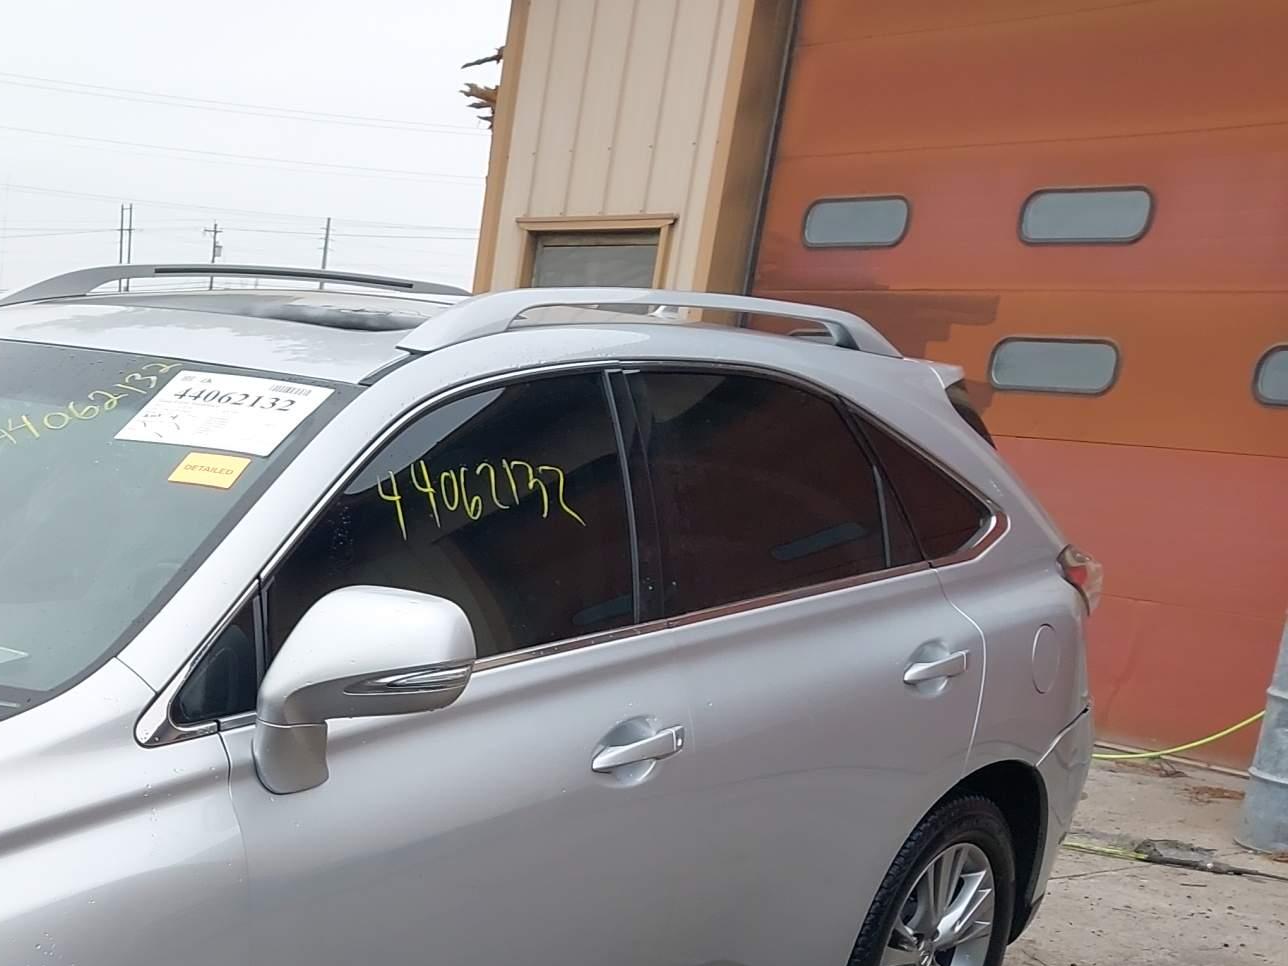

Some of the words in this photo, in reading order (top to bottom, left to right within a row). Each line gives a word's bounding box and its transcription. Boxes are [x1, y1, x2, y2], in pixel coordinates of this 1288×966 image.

[174, 386, 297, 412] 44062132
[183, 463, 234, 475] DETAILED
[376, 458, 587, 541] 44062132
